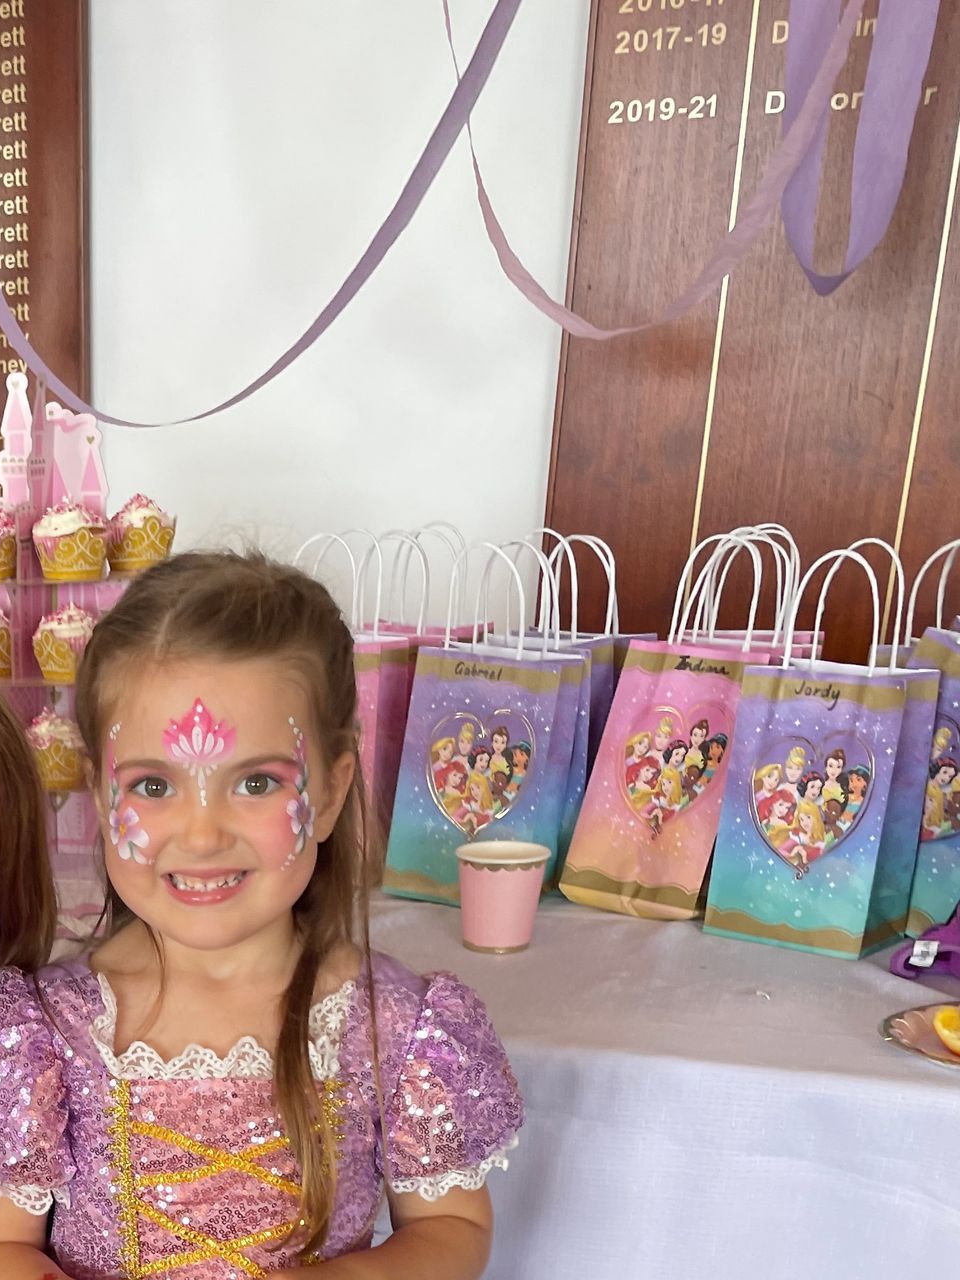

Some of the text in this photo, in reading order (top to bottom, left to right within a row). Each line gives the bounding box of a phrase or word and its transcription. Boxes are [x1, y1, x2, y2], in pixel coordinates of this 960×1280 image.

[614, 22, 727, 55] 2017-19
[608, 94, 718, 124] 2019-21
[794, 681, 841, 711] Jordy
